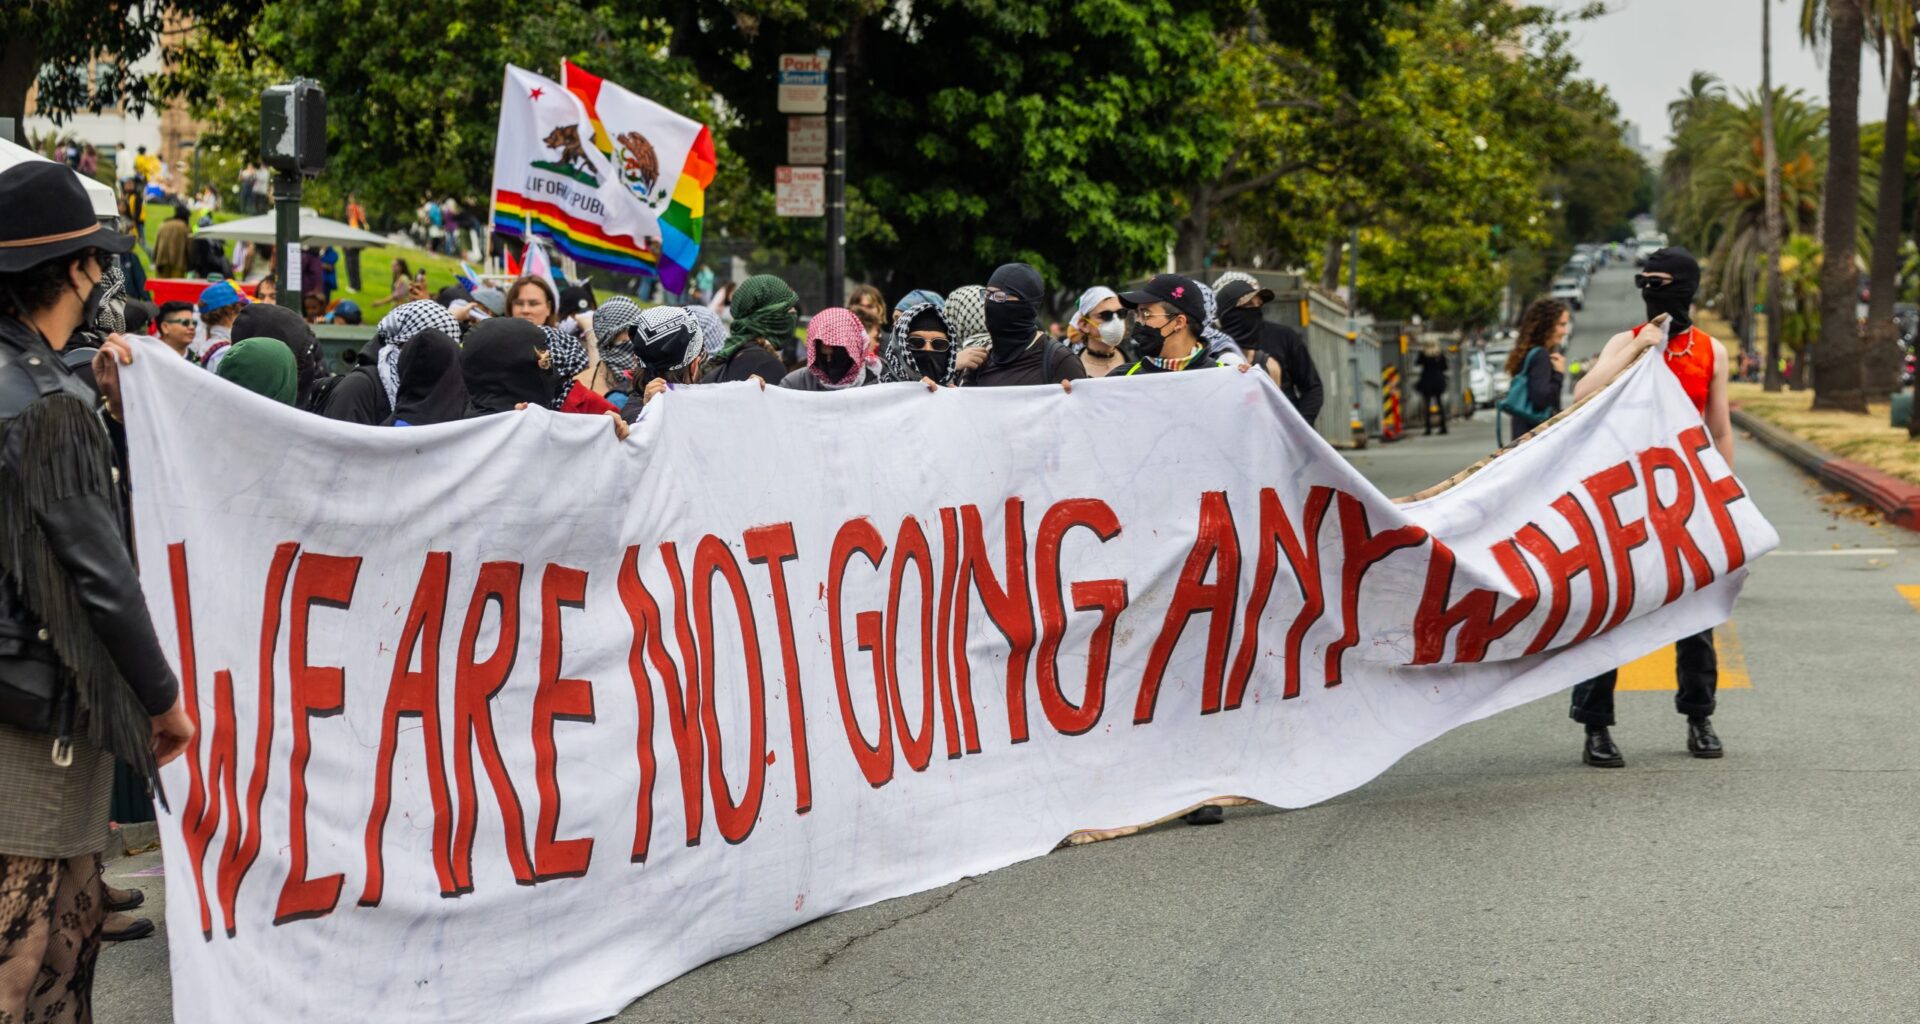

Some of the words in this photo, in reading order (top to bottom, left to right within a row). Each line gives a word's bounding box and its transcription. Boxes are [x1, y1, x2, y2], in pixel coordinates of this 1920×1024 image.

[783, 55, 822, 71] Park
[167, 541, 363, 942] WE
[357, 551, 596, 908] ARE
[617, 521, 812, 863] NOT
[827, 496, 1129, 789] GOING
